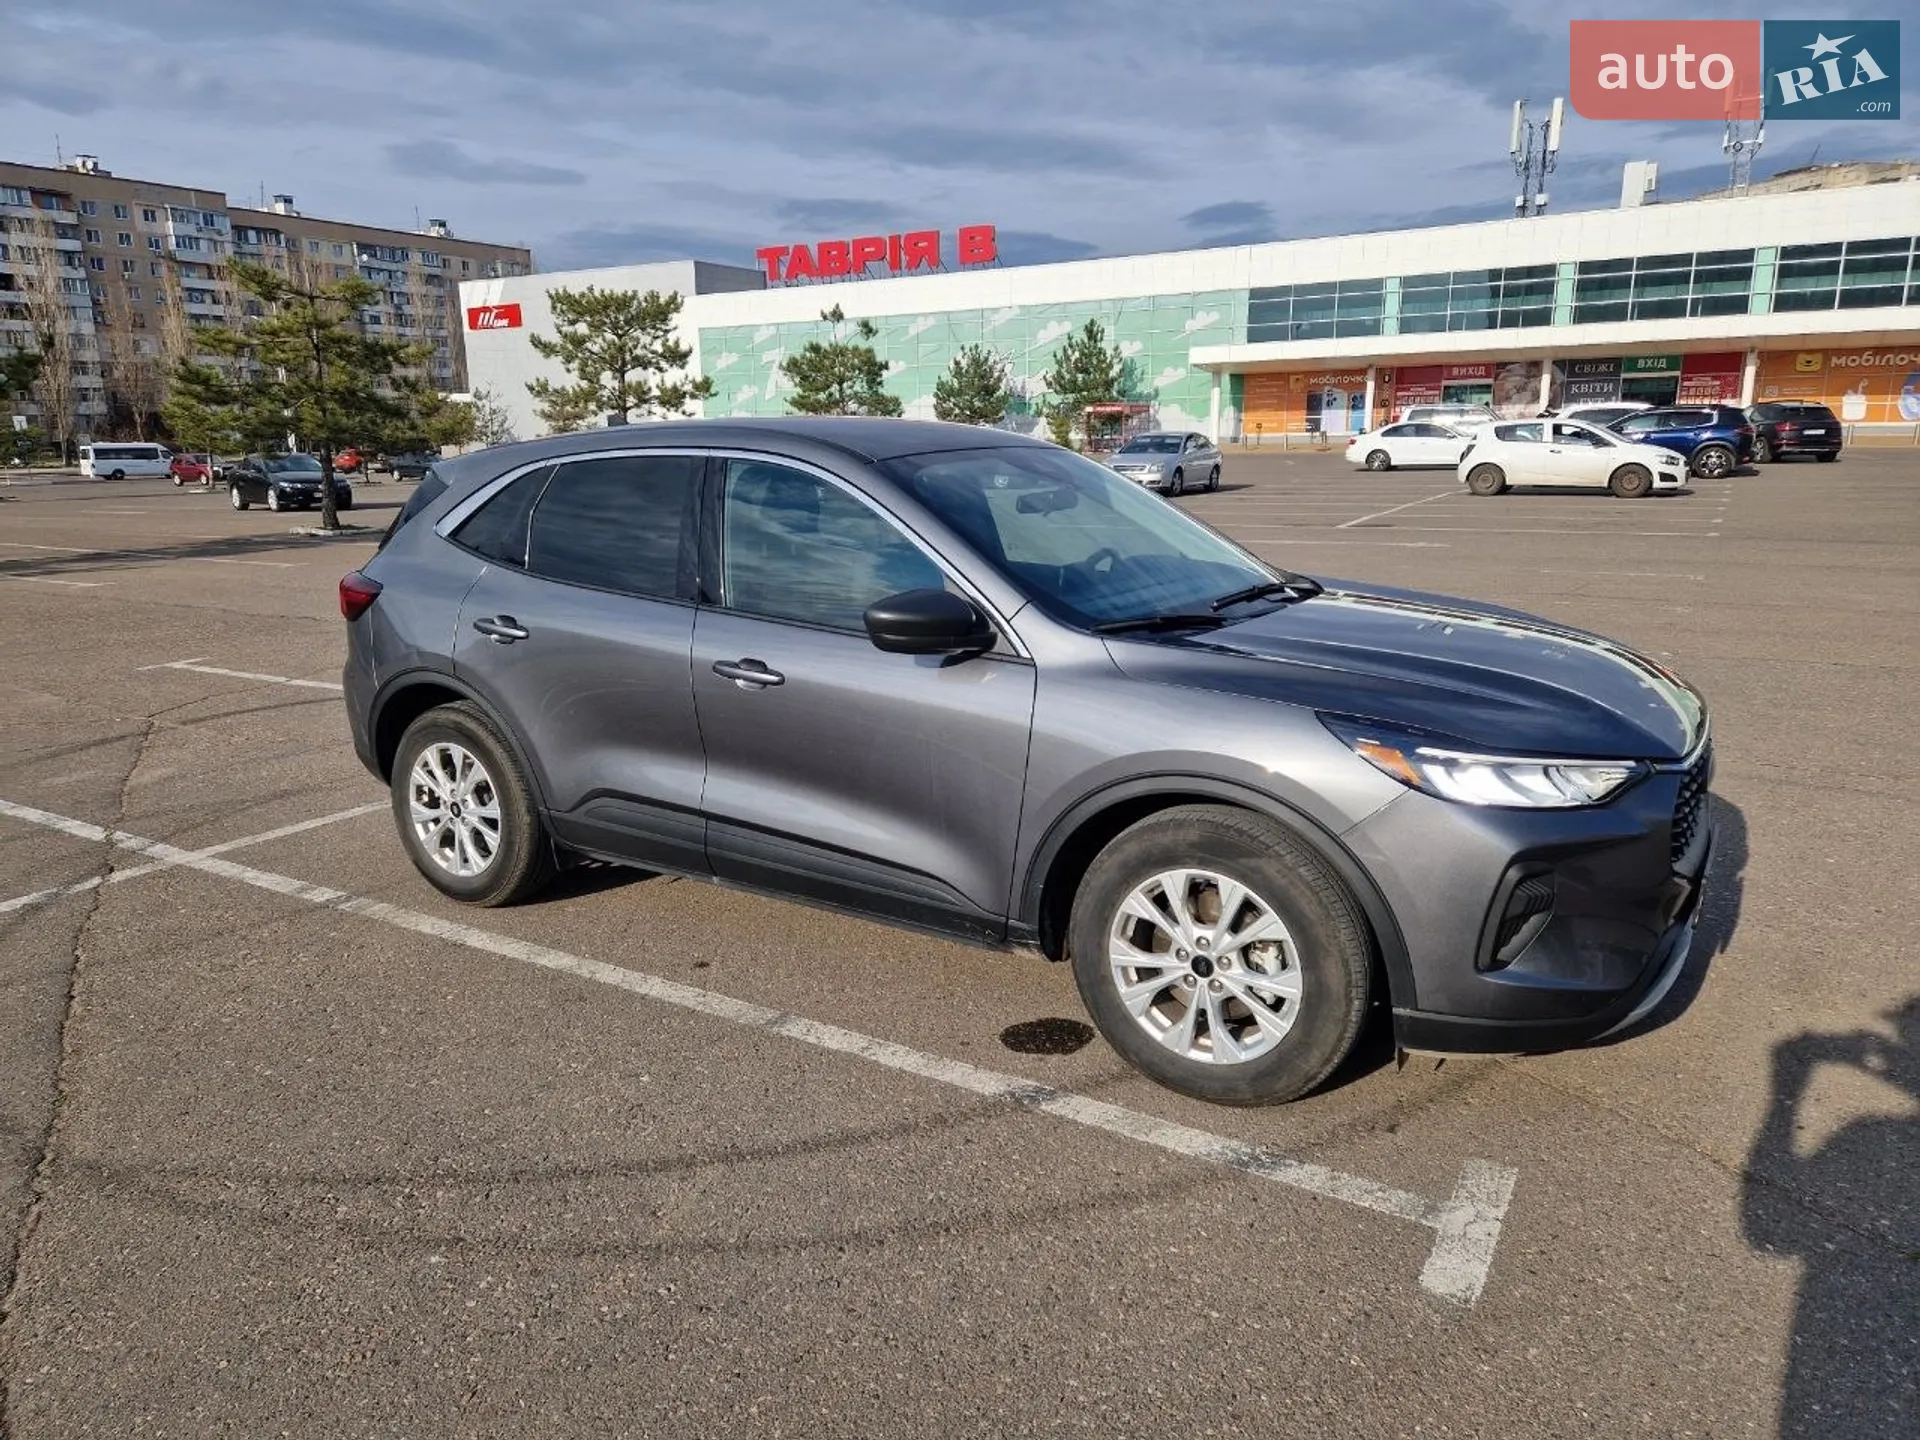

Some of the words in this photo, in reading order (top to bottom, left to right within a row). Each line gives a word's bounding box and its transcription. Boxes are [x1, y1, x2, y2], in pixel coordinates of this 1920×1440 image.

[756, 229, 940, 282] ТАВРІЯ
[958, 224, 996, 265] В
[1636, 358, 1667, 369] ВХІД
[1451, 365, 1486, 377] ВИХІД
[1570, 382, 1614, 394] КВІТИ
